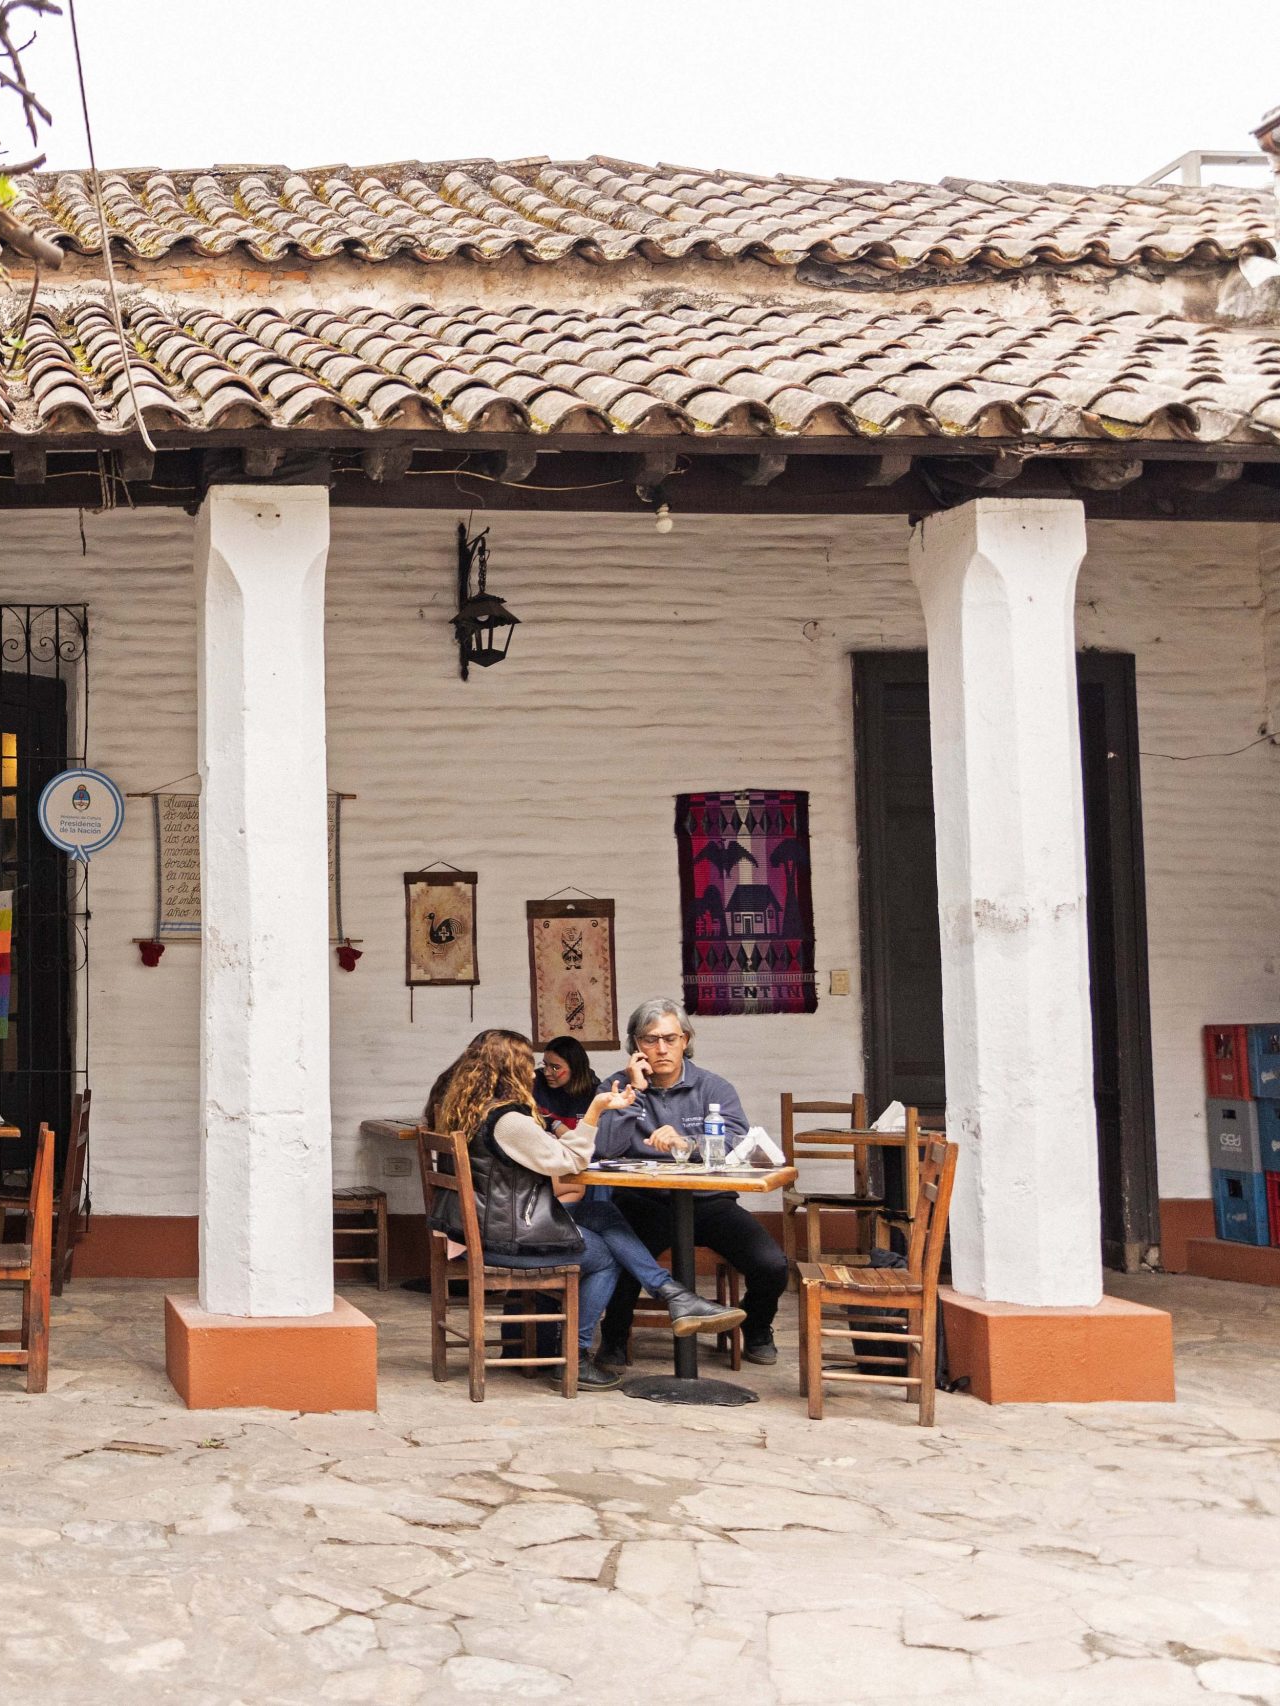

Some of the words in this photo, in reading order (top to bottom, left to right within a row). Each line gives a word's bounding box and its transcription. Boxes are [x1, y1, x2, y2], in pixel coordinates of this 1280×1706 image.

[60, 820, 101, 828] Presidencia
[167, 908, 190, 917] años
[700, 986, 801, 998] RGENTIN
